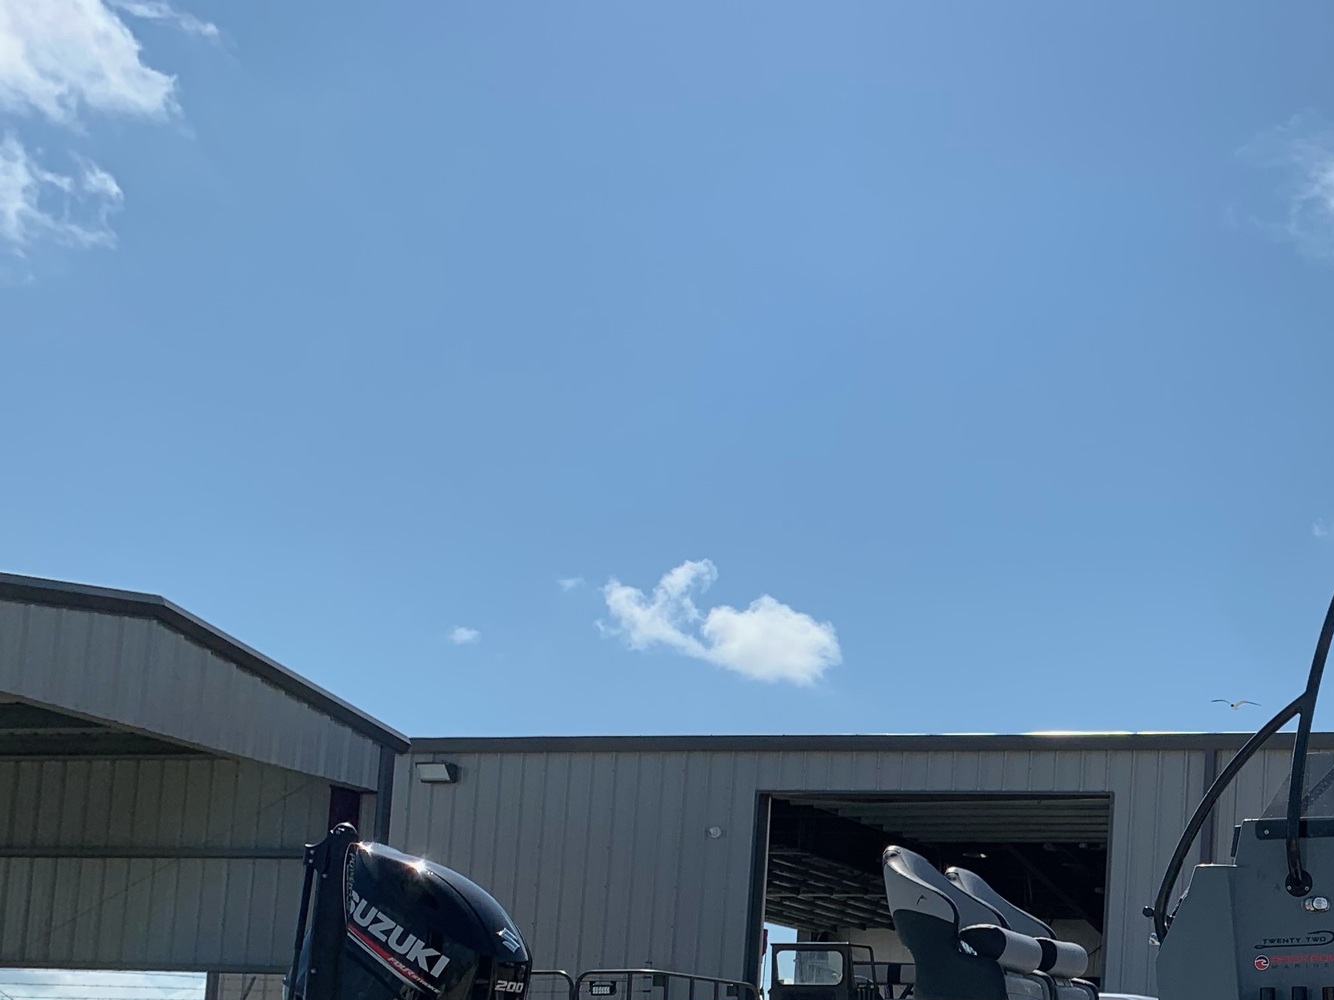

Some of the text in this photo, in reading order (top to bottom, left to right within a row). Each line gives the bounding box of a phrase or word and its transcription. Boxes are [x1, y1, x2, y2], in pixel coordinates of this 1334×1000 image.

[349, 890, 450, 978] SUZUKI
[1262, 937, 1301, 945] TWENTY
[494, 980, 524, 993] 200
